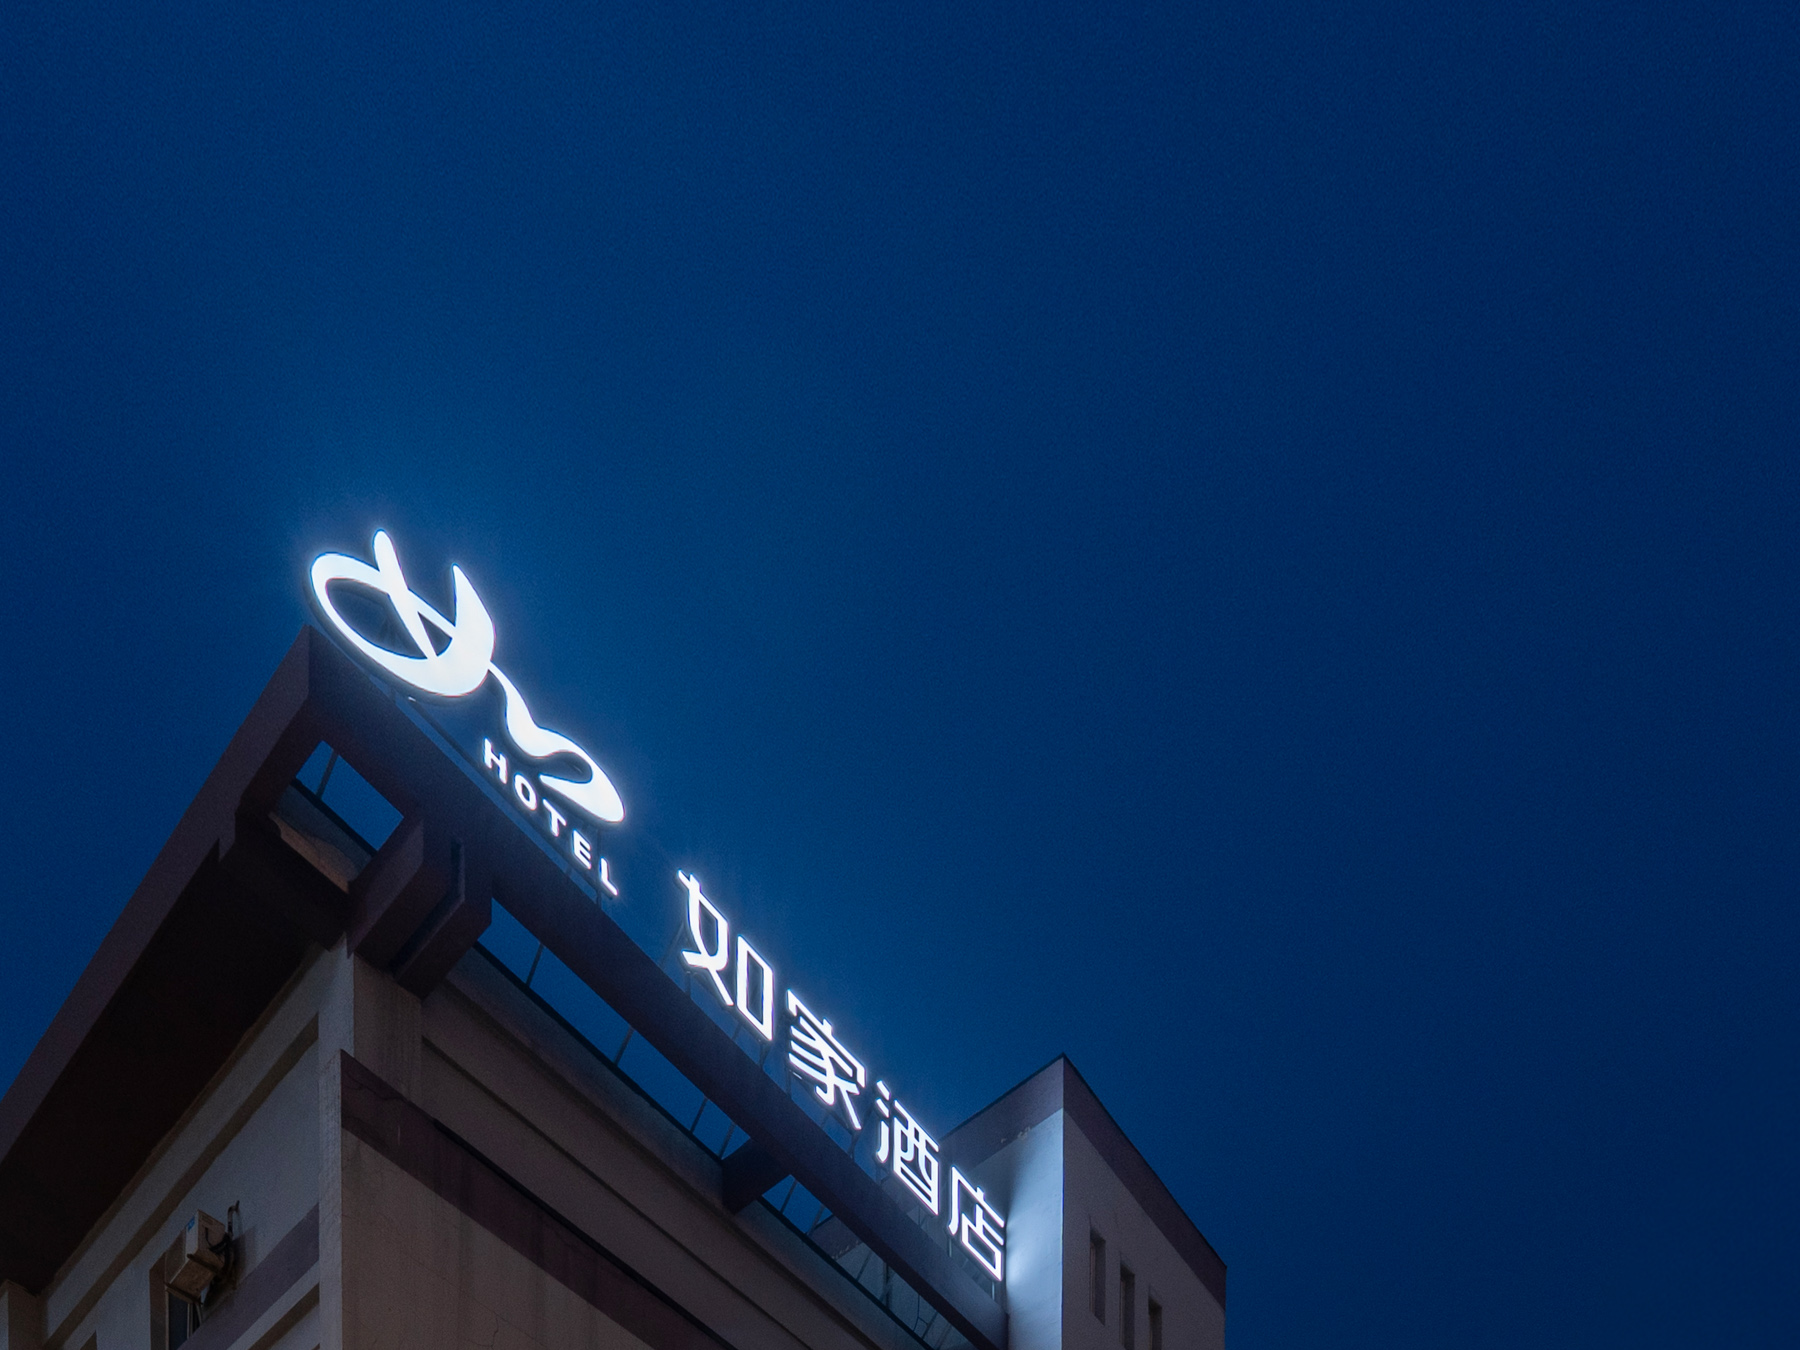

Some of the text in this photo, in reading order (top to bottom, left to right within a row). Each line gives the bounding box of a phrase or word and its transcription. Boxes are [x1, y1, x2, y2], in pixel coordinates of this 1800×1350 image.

[484, 737, 618, 896] HOTEL
[678, 869, 1005, 1281] 如家酒店
